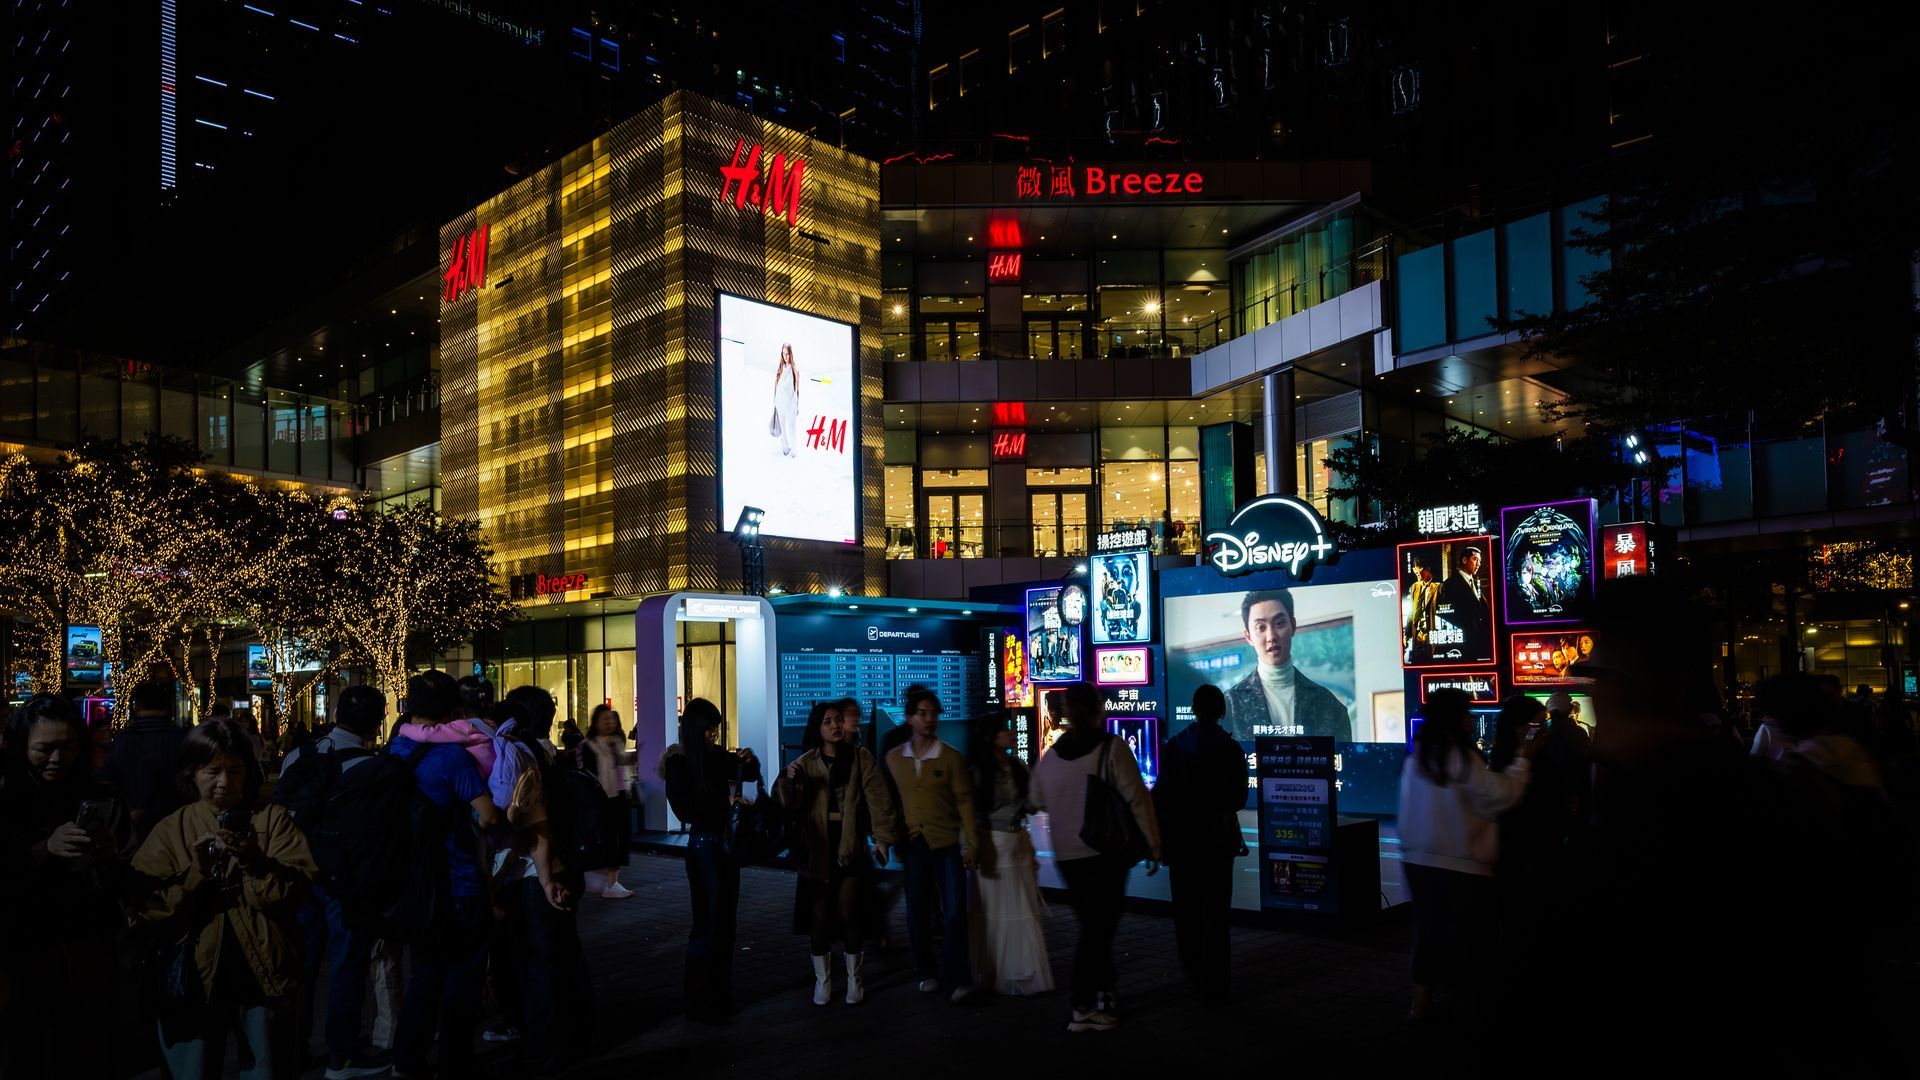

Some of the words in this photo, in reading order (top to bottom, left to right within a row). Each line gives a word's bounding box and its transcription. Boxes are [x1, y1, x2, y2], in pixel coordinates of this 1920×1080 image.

[720, 138, 805, 228] H&M
[1017, 165, 1075, 199] 微風
[1086, 167, 1204, 195] Breeze
[444, 223, 489, 303] H&M
[989, 253, 1022, 278] H&M
[805, 415, 848, 455] H&M
[993, 432, 1026, 456] H&M
[1418, 503, 1479, 534] 韓國製造
[1097, 530, 1147, 550] 操控遊戲
[1206, 528, 1332, 576] Disney+
[536, 573, 586, 595] Breeze
[1118, 689, 1139, 700] 宇宙
[1462, 681, 1490, 692] KOREA
[1105, 699, 1136, 711] MARRY
[1137, 701, 1156, 711] ME?
[1253, 724, 1304, 735] 要夠多元才有趣
[1275, 829, 1293, 839] 335
